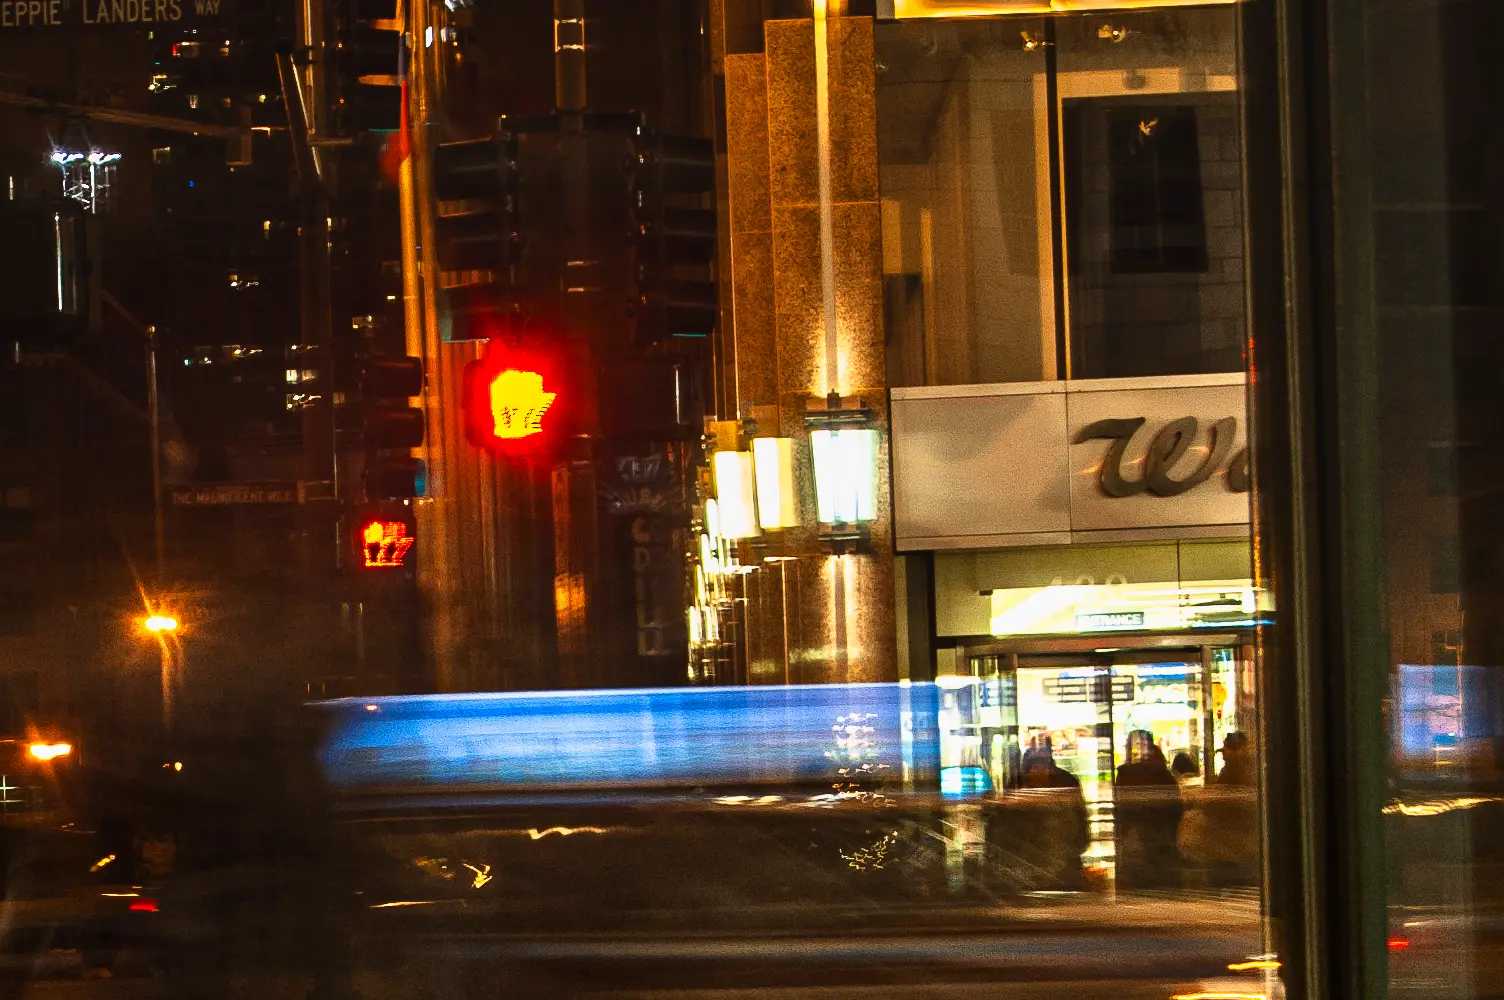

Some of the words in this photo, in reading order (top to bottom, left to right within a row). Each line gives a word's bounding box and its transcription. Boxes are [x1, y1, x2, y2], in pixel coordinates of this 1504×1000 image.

[83, 0, 182, 24] LANDERS
[194, 0, 221, 16] WAY
[1076, 613, 1142, 627] NTRANCE
